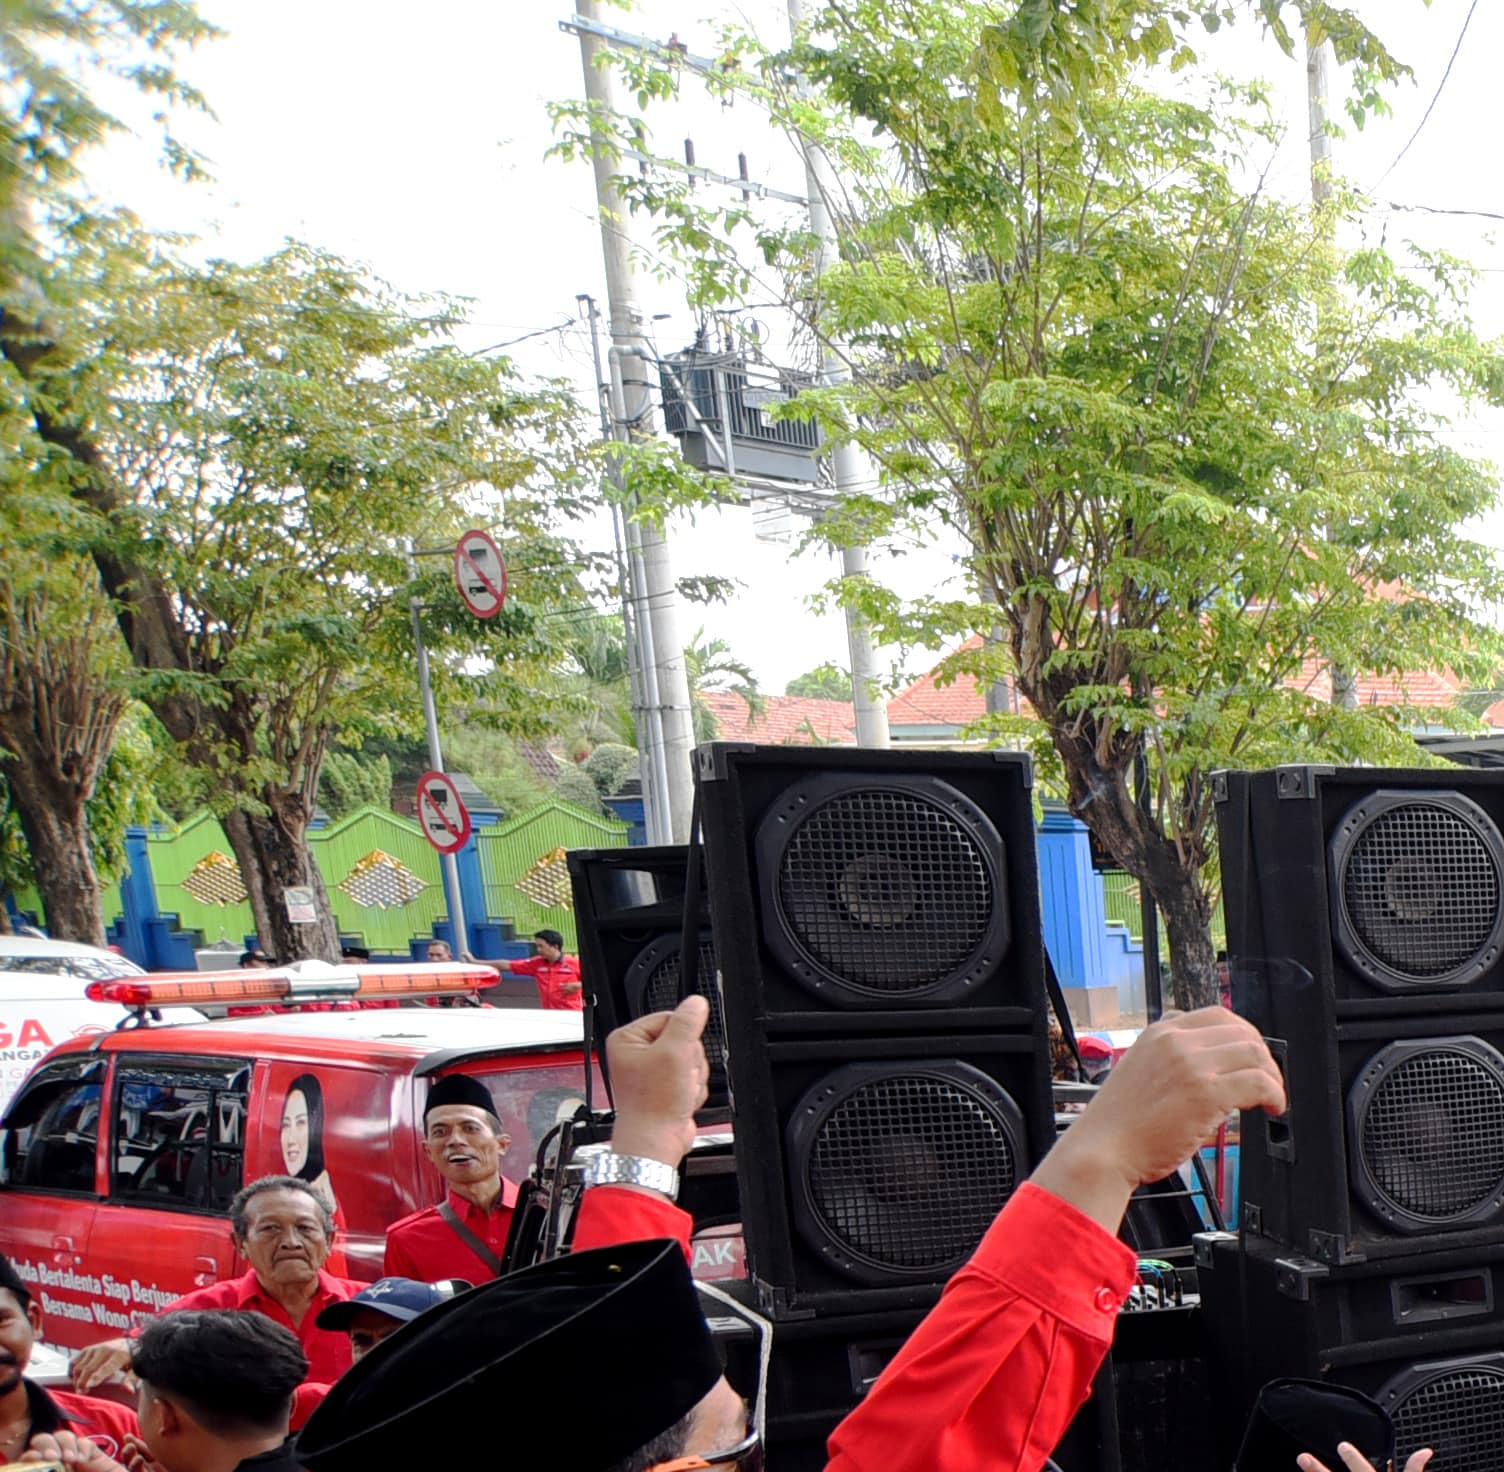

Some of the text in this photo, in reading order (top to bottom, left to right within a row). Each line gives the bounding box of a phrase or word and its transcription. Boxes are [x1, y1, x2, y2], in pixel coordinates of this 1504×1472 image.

[37, 1262, 101, 1295] Bertalenta
[102, 1274, 130, 1306] Siap
[131, 1280, 186, 1312] Berjuan
[40, 1292, 93, 1322] Bersama
